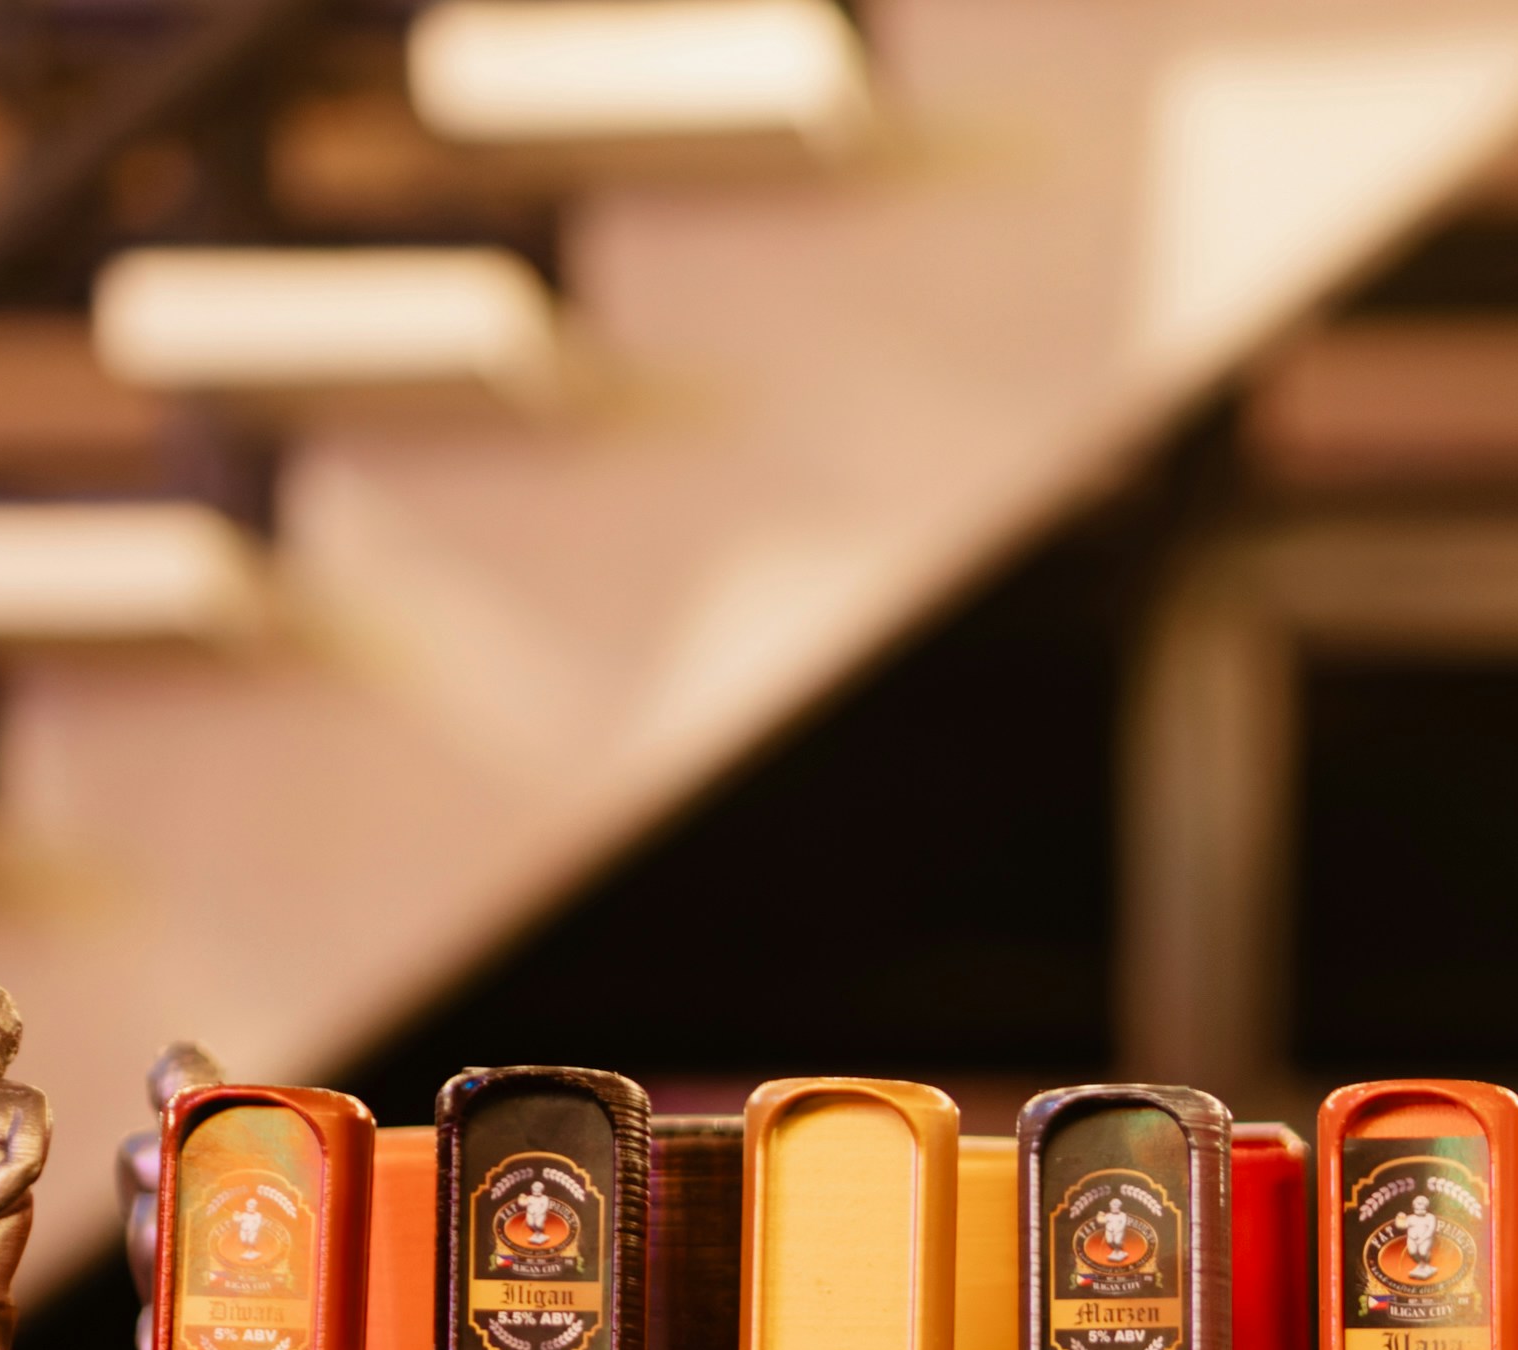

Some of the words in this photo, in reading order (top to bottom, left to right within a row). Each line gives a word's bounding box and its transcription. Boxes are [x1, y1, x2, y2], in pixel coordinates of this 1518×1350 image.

[500, 1282, 575, 1308] Iligan
[497, 1311, 536, 1325] 5.5%
[540, 1311, 575, 1325] ABV
[1074, 1302, 1160, 1326] Marzen
[1390, 1305, 1426, 1318] ILIGAN
[1429, 1304, 1454, 1317] CITY
[214, 1328, 239, 1341] 5%
[243, 1329, 277, 1342] ABV
[1088, 1330, 1111, 1343] 5%
[1115, 1330, 1146, 1342] ABV
